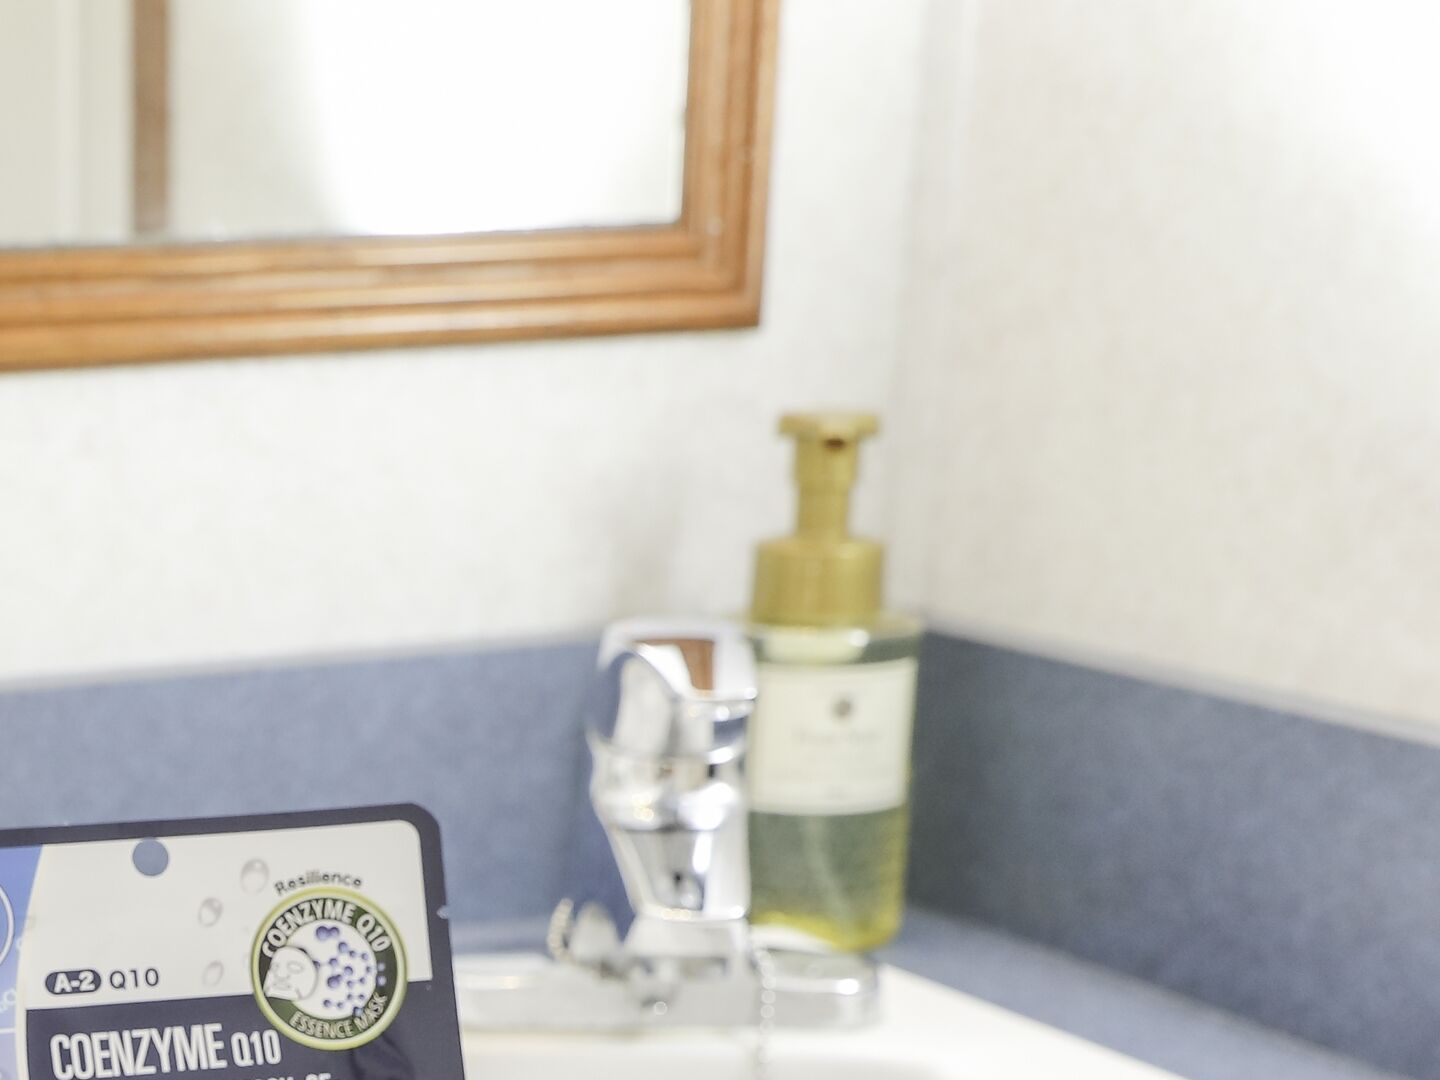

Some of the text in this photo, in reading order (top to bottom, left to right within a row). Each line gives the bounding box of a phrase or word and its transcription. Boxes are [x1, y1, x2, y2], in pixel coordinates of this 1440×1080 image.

[273, 870, 362, 895] Resilience
[261, 898, 393, 958] COENZYME Q10
[54, 968, 159, 993] A-2 Q10
[289, 991, 388, 1039] ESSENCE MASK
[50, 1023, 282, 1080] COENZYME Q10
